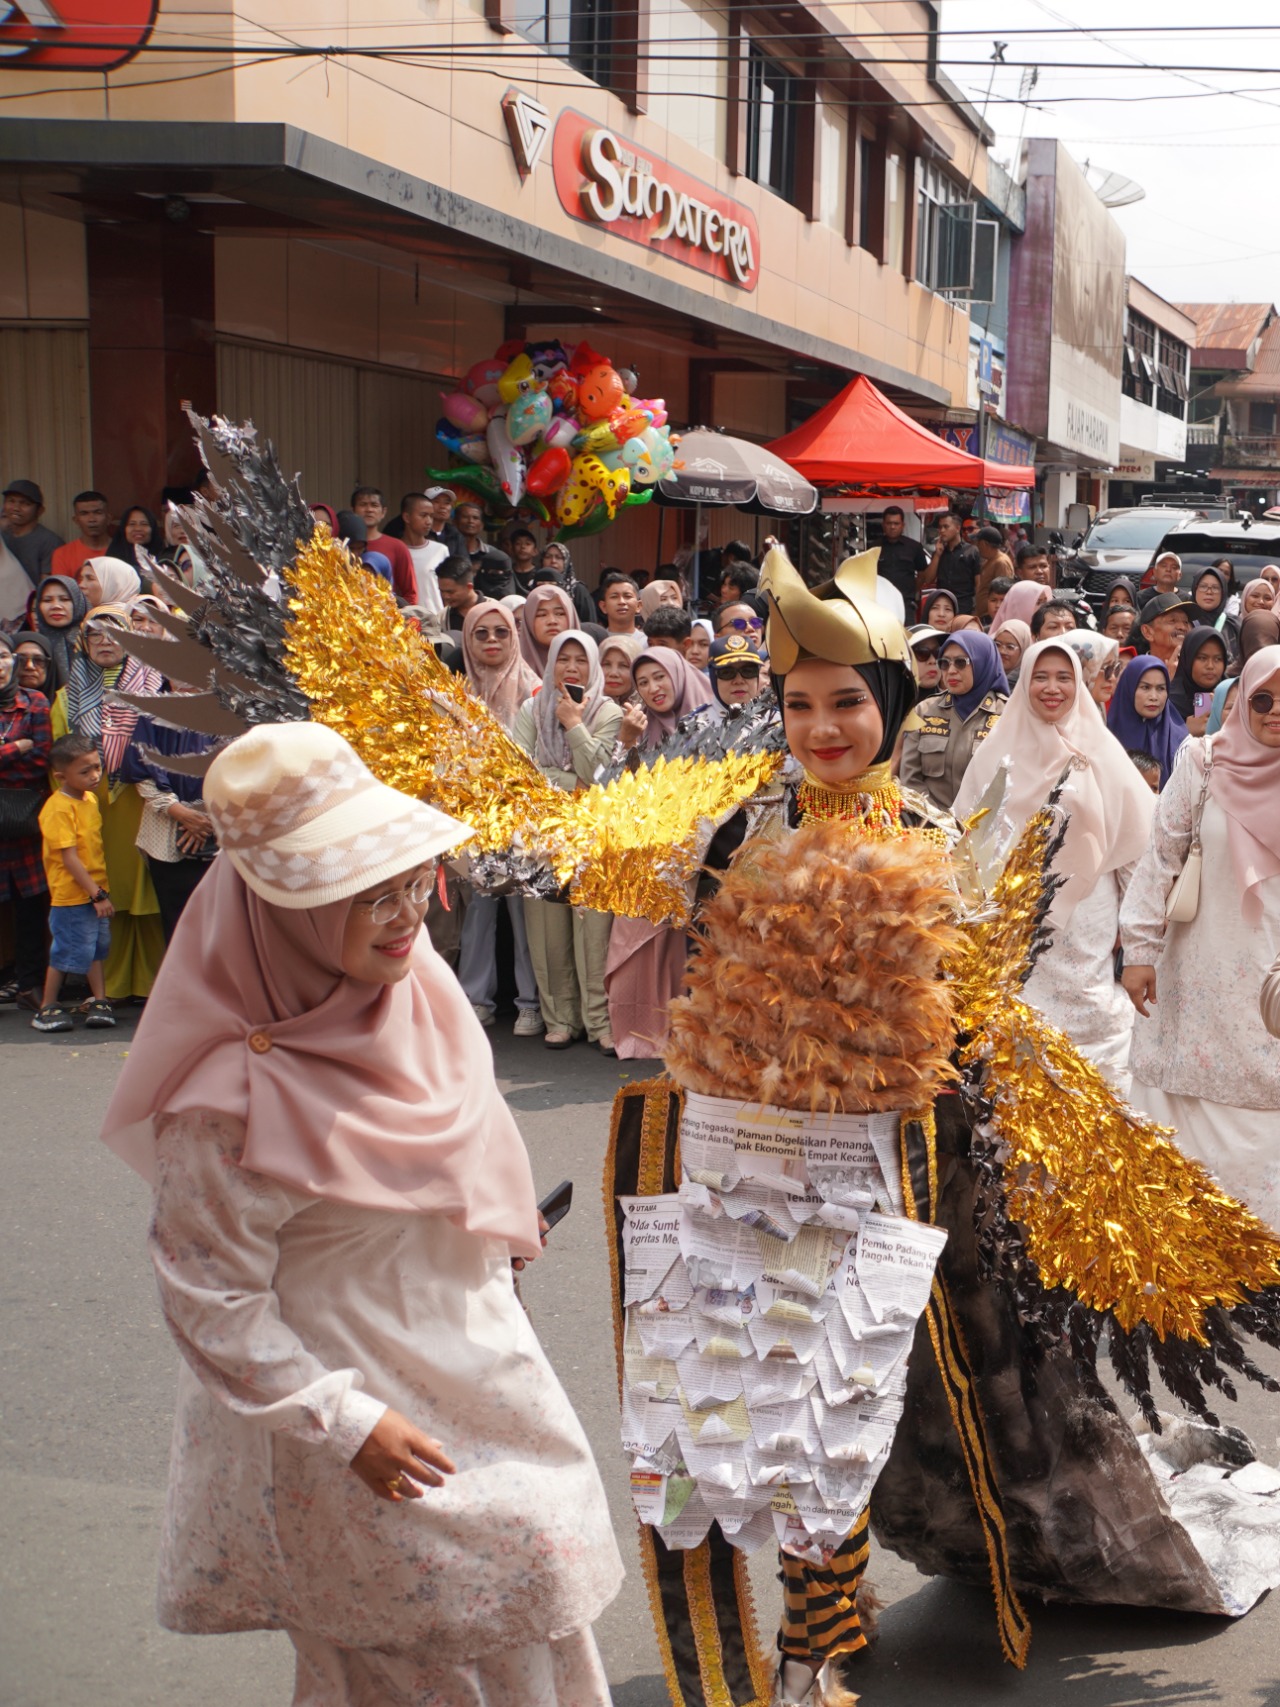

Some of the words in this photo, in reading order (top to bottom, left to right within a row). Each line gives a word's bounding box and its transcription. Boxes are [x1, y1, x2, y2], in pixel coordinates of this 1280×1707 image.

[982, 344, 989, 376] P
[1067, 402, 1085, 444] FAJAR
[1085, 411, 1109, 454] HARAPAN
[920, 726, 948, 735] ROSSY
[701, 1121, 736, 1134] Tegaska
[737, 1128, 773, 1142] Piaman
[734, 1141, 752, 1151] pak
[754, 1142, 796, 1157] Ekonomi
[808, 1150, 838, 1163] Empat
[636, 1204, 657, 1212] UTAMA
[662, 1233, 680, 1245] Me
[861, 1238, 894, 1251] Pemko
[895, 1243, 927, 1260] Padang
[860, 1249, 896, 1264] Tangah,
[898, 1255, 924, 1269] Tekan
[812, 1505, 836, 1515] dalam
